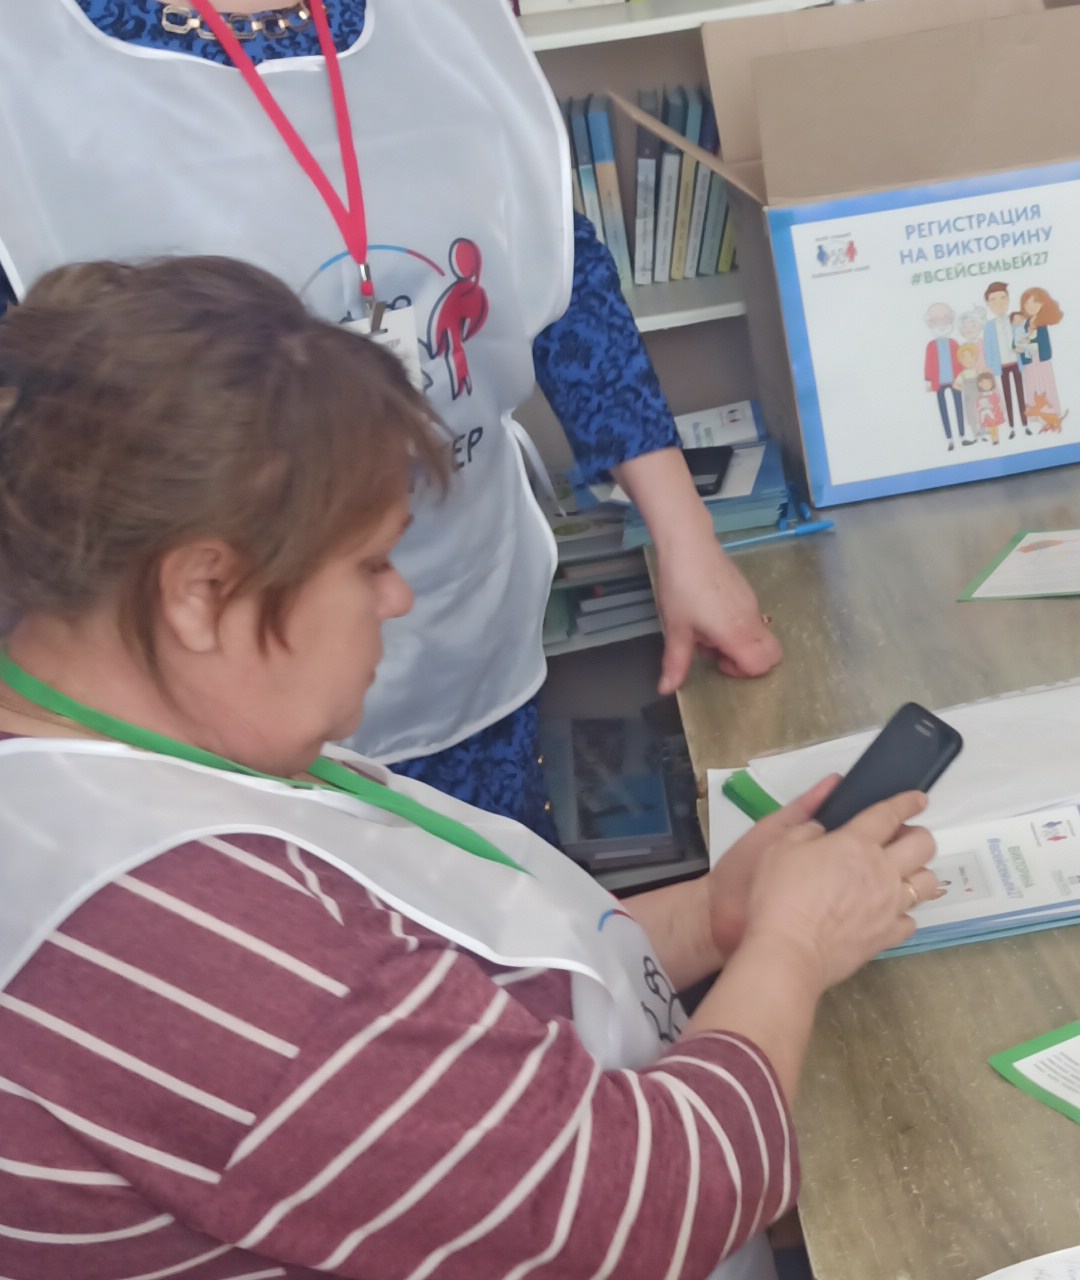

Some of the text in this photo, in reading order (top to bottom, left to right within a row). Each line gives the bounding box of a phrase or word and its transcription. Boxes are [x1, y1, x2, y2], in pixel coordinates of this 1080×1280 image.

[905, 204, 1042, 240] РЕГИСТРАЦИЯ
[899, 225, 1053, 265] НА ВИКТОРИНУ
[911, 251, 1050, 286] #ВСЕЙСЕМЬЕЙ27
